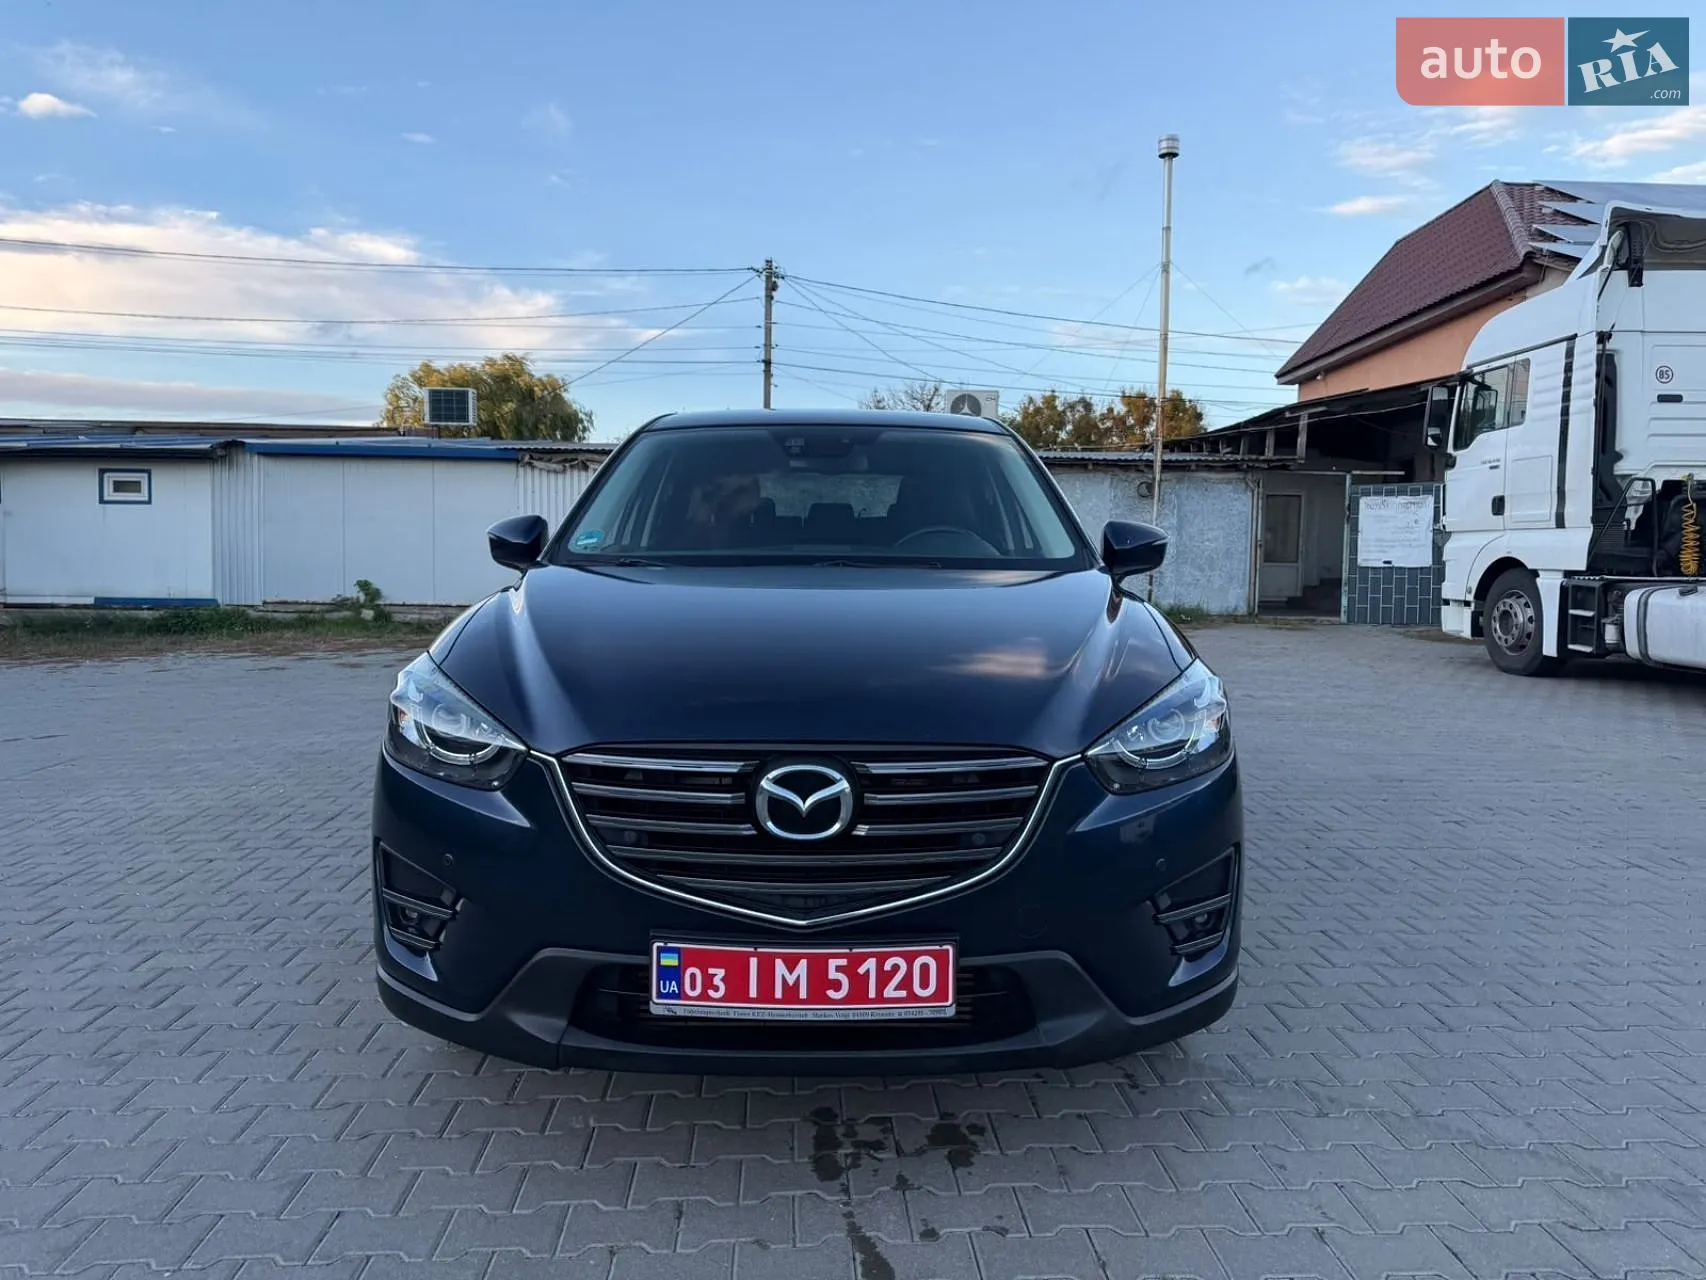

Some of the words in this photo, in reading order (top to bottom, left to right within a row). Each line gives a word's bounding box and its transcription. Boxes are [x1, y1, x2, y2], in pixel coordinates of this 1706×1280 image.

[1659, 369, 1670, 381] 85
[683, 967, 726, 999] 03
[749, 957, 808, 999] IM
[825, 955, 937, 1000] 5120
[660, 980, 679, 994] UA
